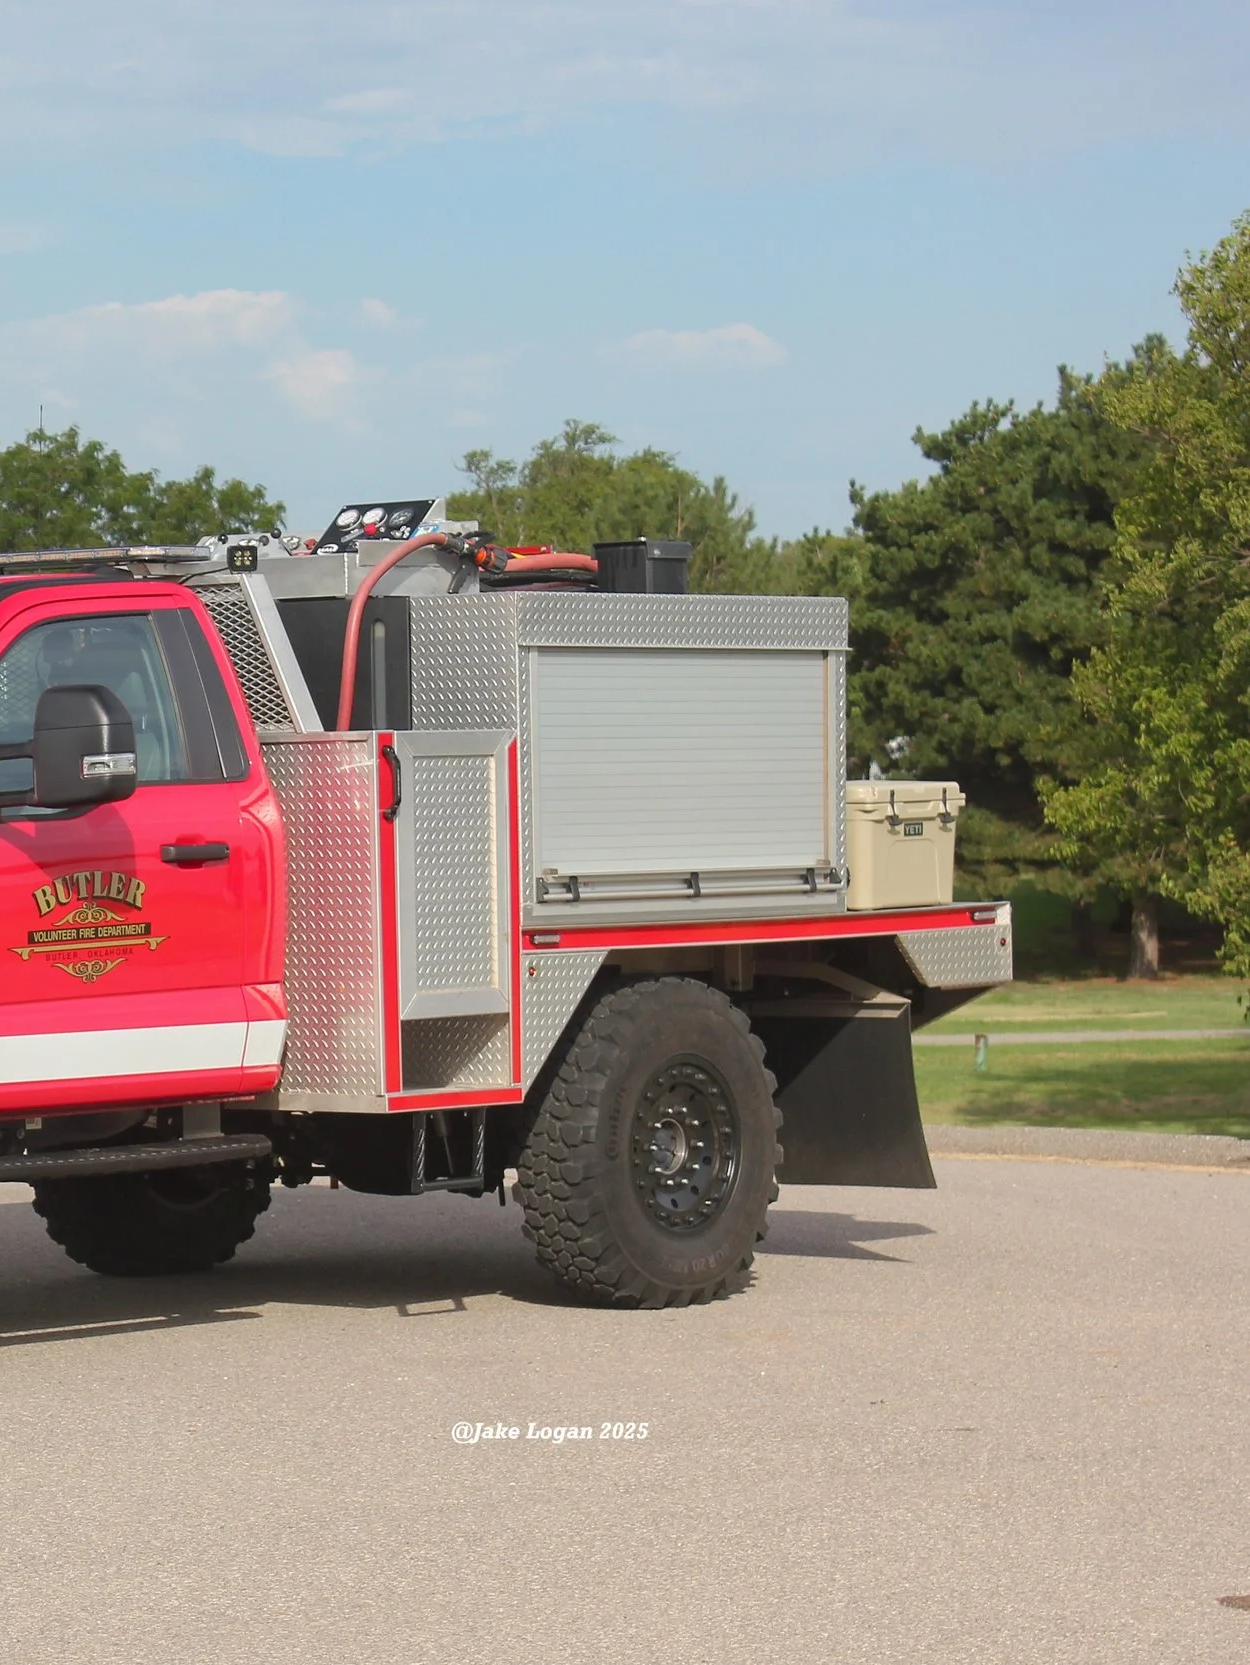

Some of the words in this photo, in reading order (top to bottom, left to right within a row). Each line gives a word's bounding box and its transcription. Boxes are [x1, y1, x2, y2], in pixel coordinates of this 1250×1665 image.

[905, 824, 922, 835] YETI
[32, 870, 146, 917] BUTLER
[33, 929, 77, 942] VOLUNTEER
[79, 927, 96, 939] FIRE
[97, 923, 146, 937] DEPARTMENT
[87, 947, 133, 958] OKLAHOMA
